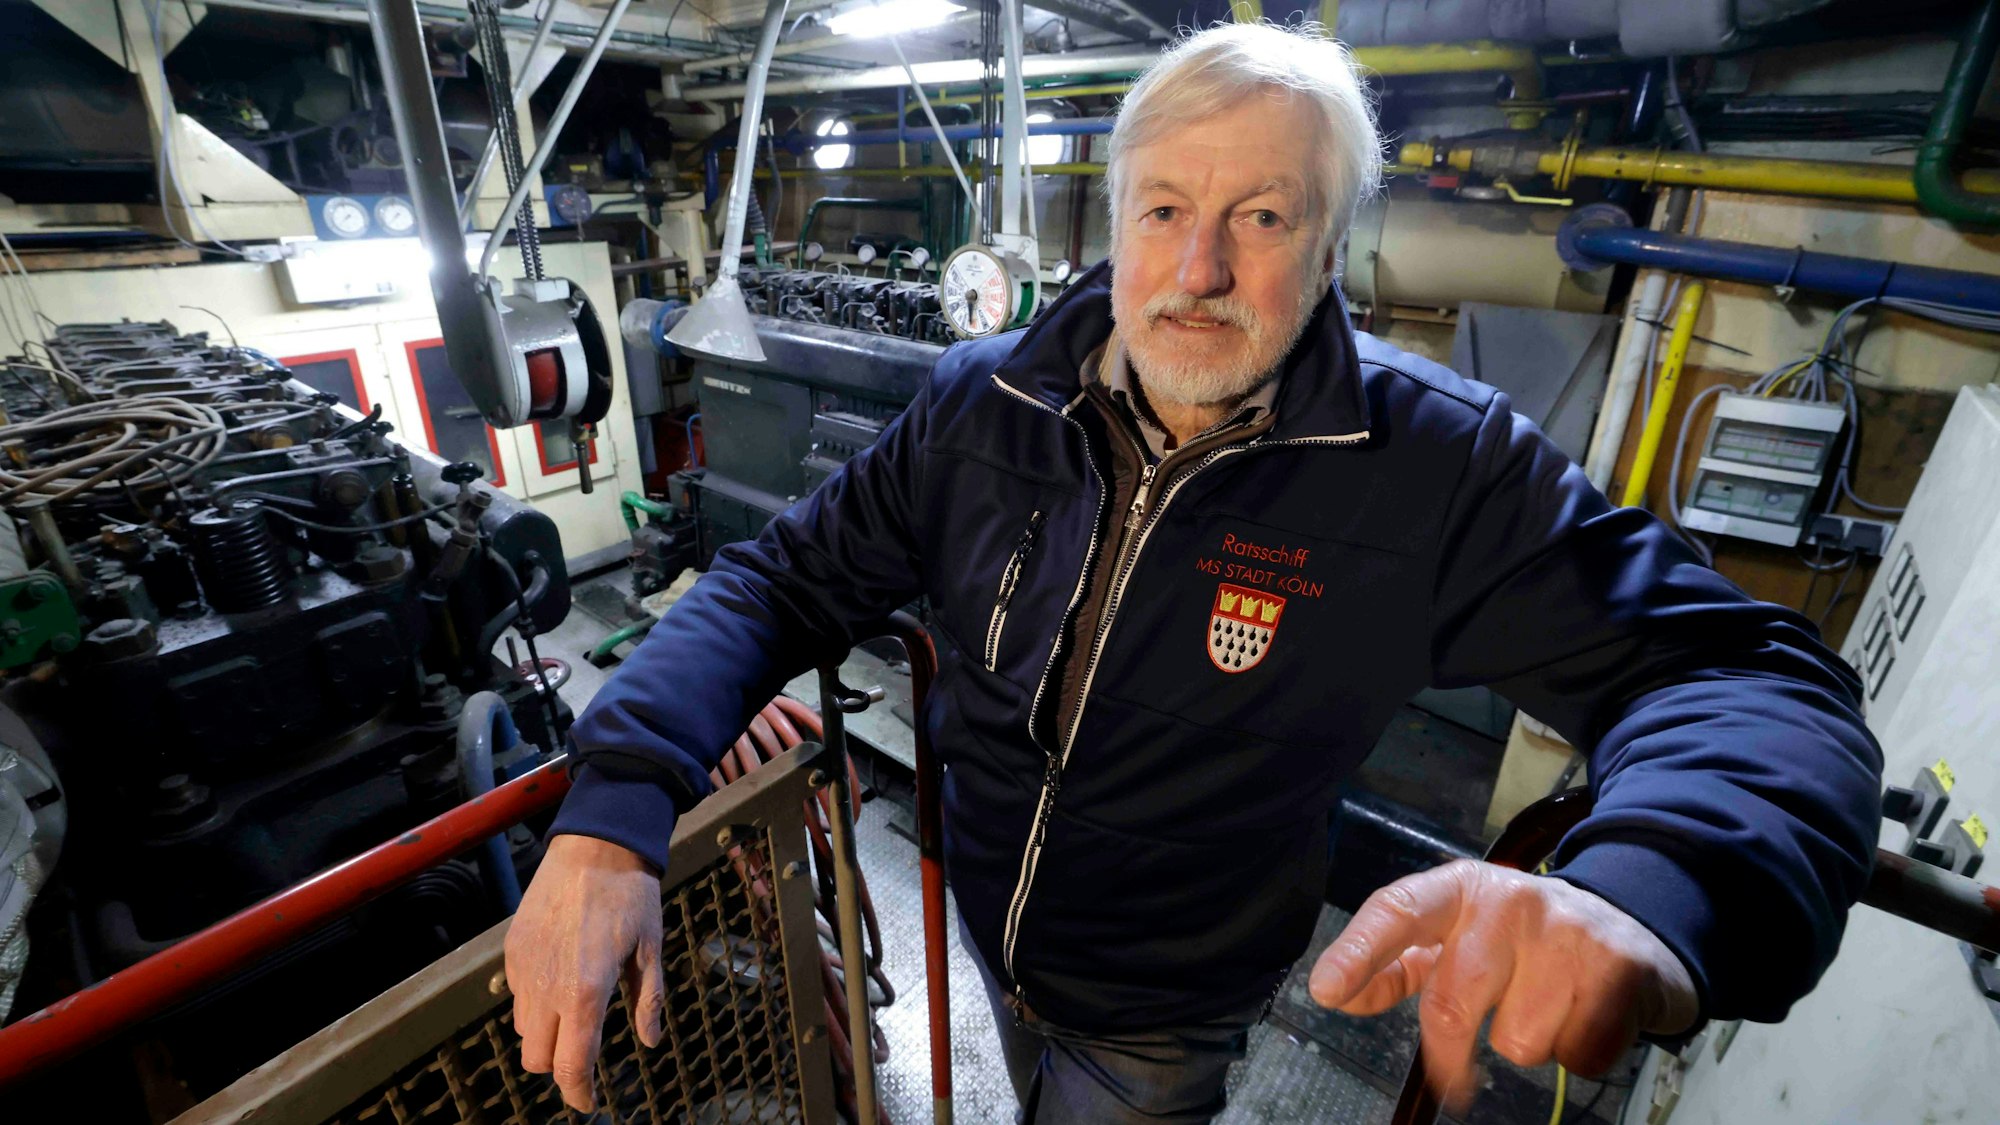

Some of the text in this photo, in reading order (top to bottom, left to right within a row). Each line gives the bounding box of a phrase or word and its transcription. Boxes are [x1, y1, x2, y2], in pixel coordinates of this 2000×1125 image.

[1222, 533, 1310, 568] Ratsschiff
[1196, 557, 1324, 598] MS STADT KÖLN
